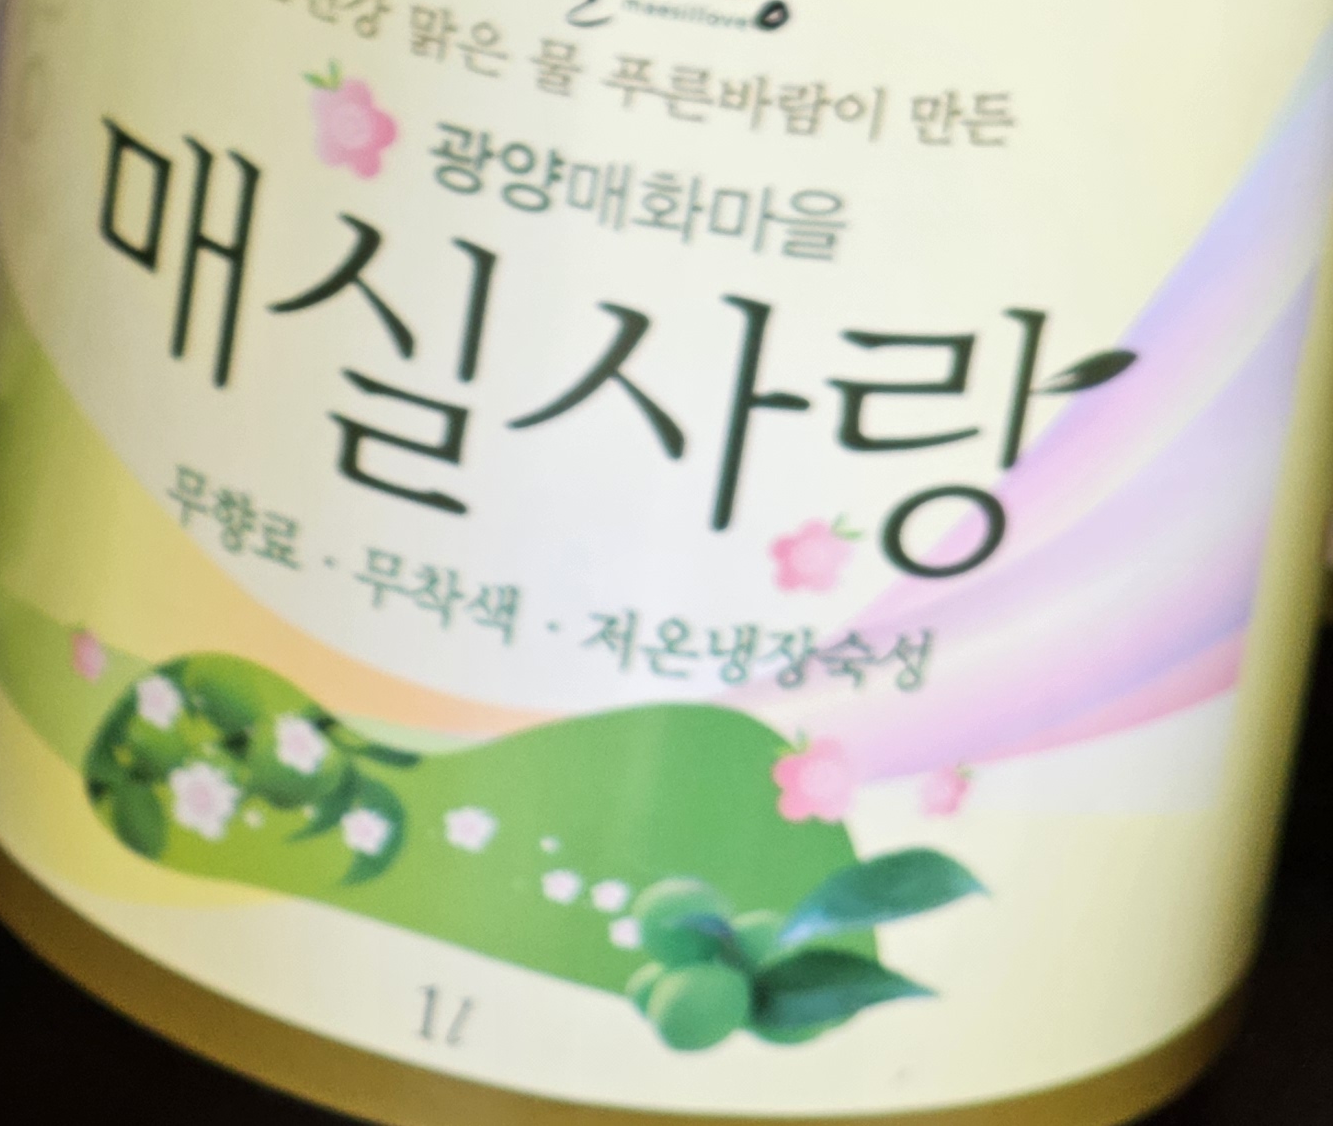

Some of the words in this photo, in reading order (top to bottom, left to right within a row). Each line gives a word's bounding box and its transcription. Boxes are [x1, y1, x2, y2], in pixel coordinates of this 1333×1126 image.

[408, 3, 508, 78] 맑은
[530, 36, 583, 97] 물
[601, 53, 888, 142] 푸른바람이
[911, 87, 1017, 147] 만든
[430, 121, 848, 261] 광양매화마을
[99, 115, 1138, 578] 매실사랑
[167, 463, 302, 571] 무향료
[354, 546, 520, 646] 무착색
[581, 607, 935, 692] 저온냉장숙성
